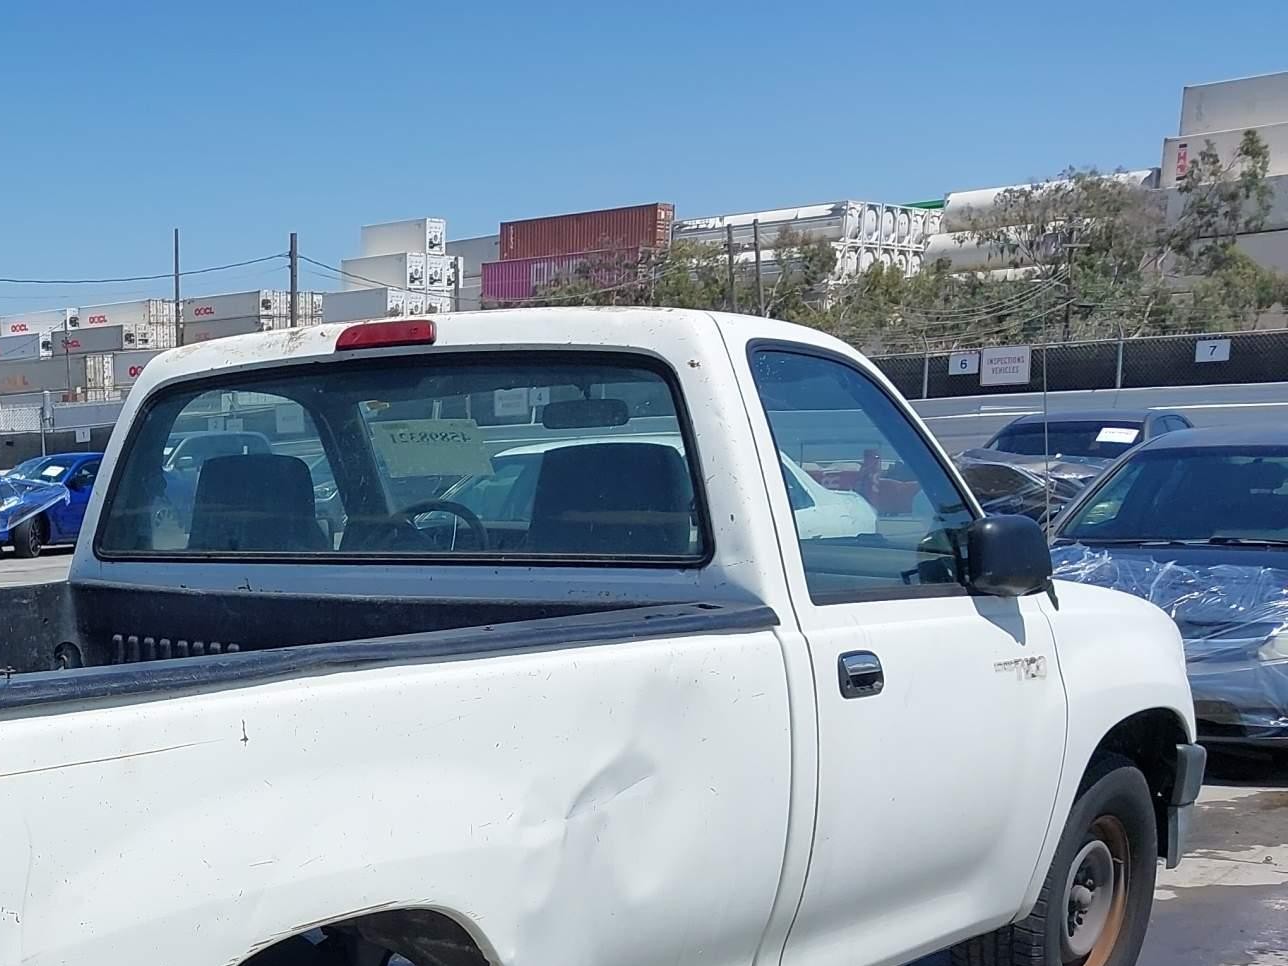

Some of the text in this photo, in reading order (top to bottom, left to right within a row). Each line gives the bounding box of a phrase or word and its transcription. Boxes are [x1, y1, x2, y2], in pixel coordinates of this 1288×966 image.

[194, 306, 215, 316] OOCL
[88, 314, 108, 325] OOCL
[11, 322, 29, 333] OOCL
[1209, 345, 1217, 356] 7
[960, 358, 968, 370] 6
